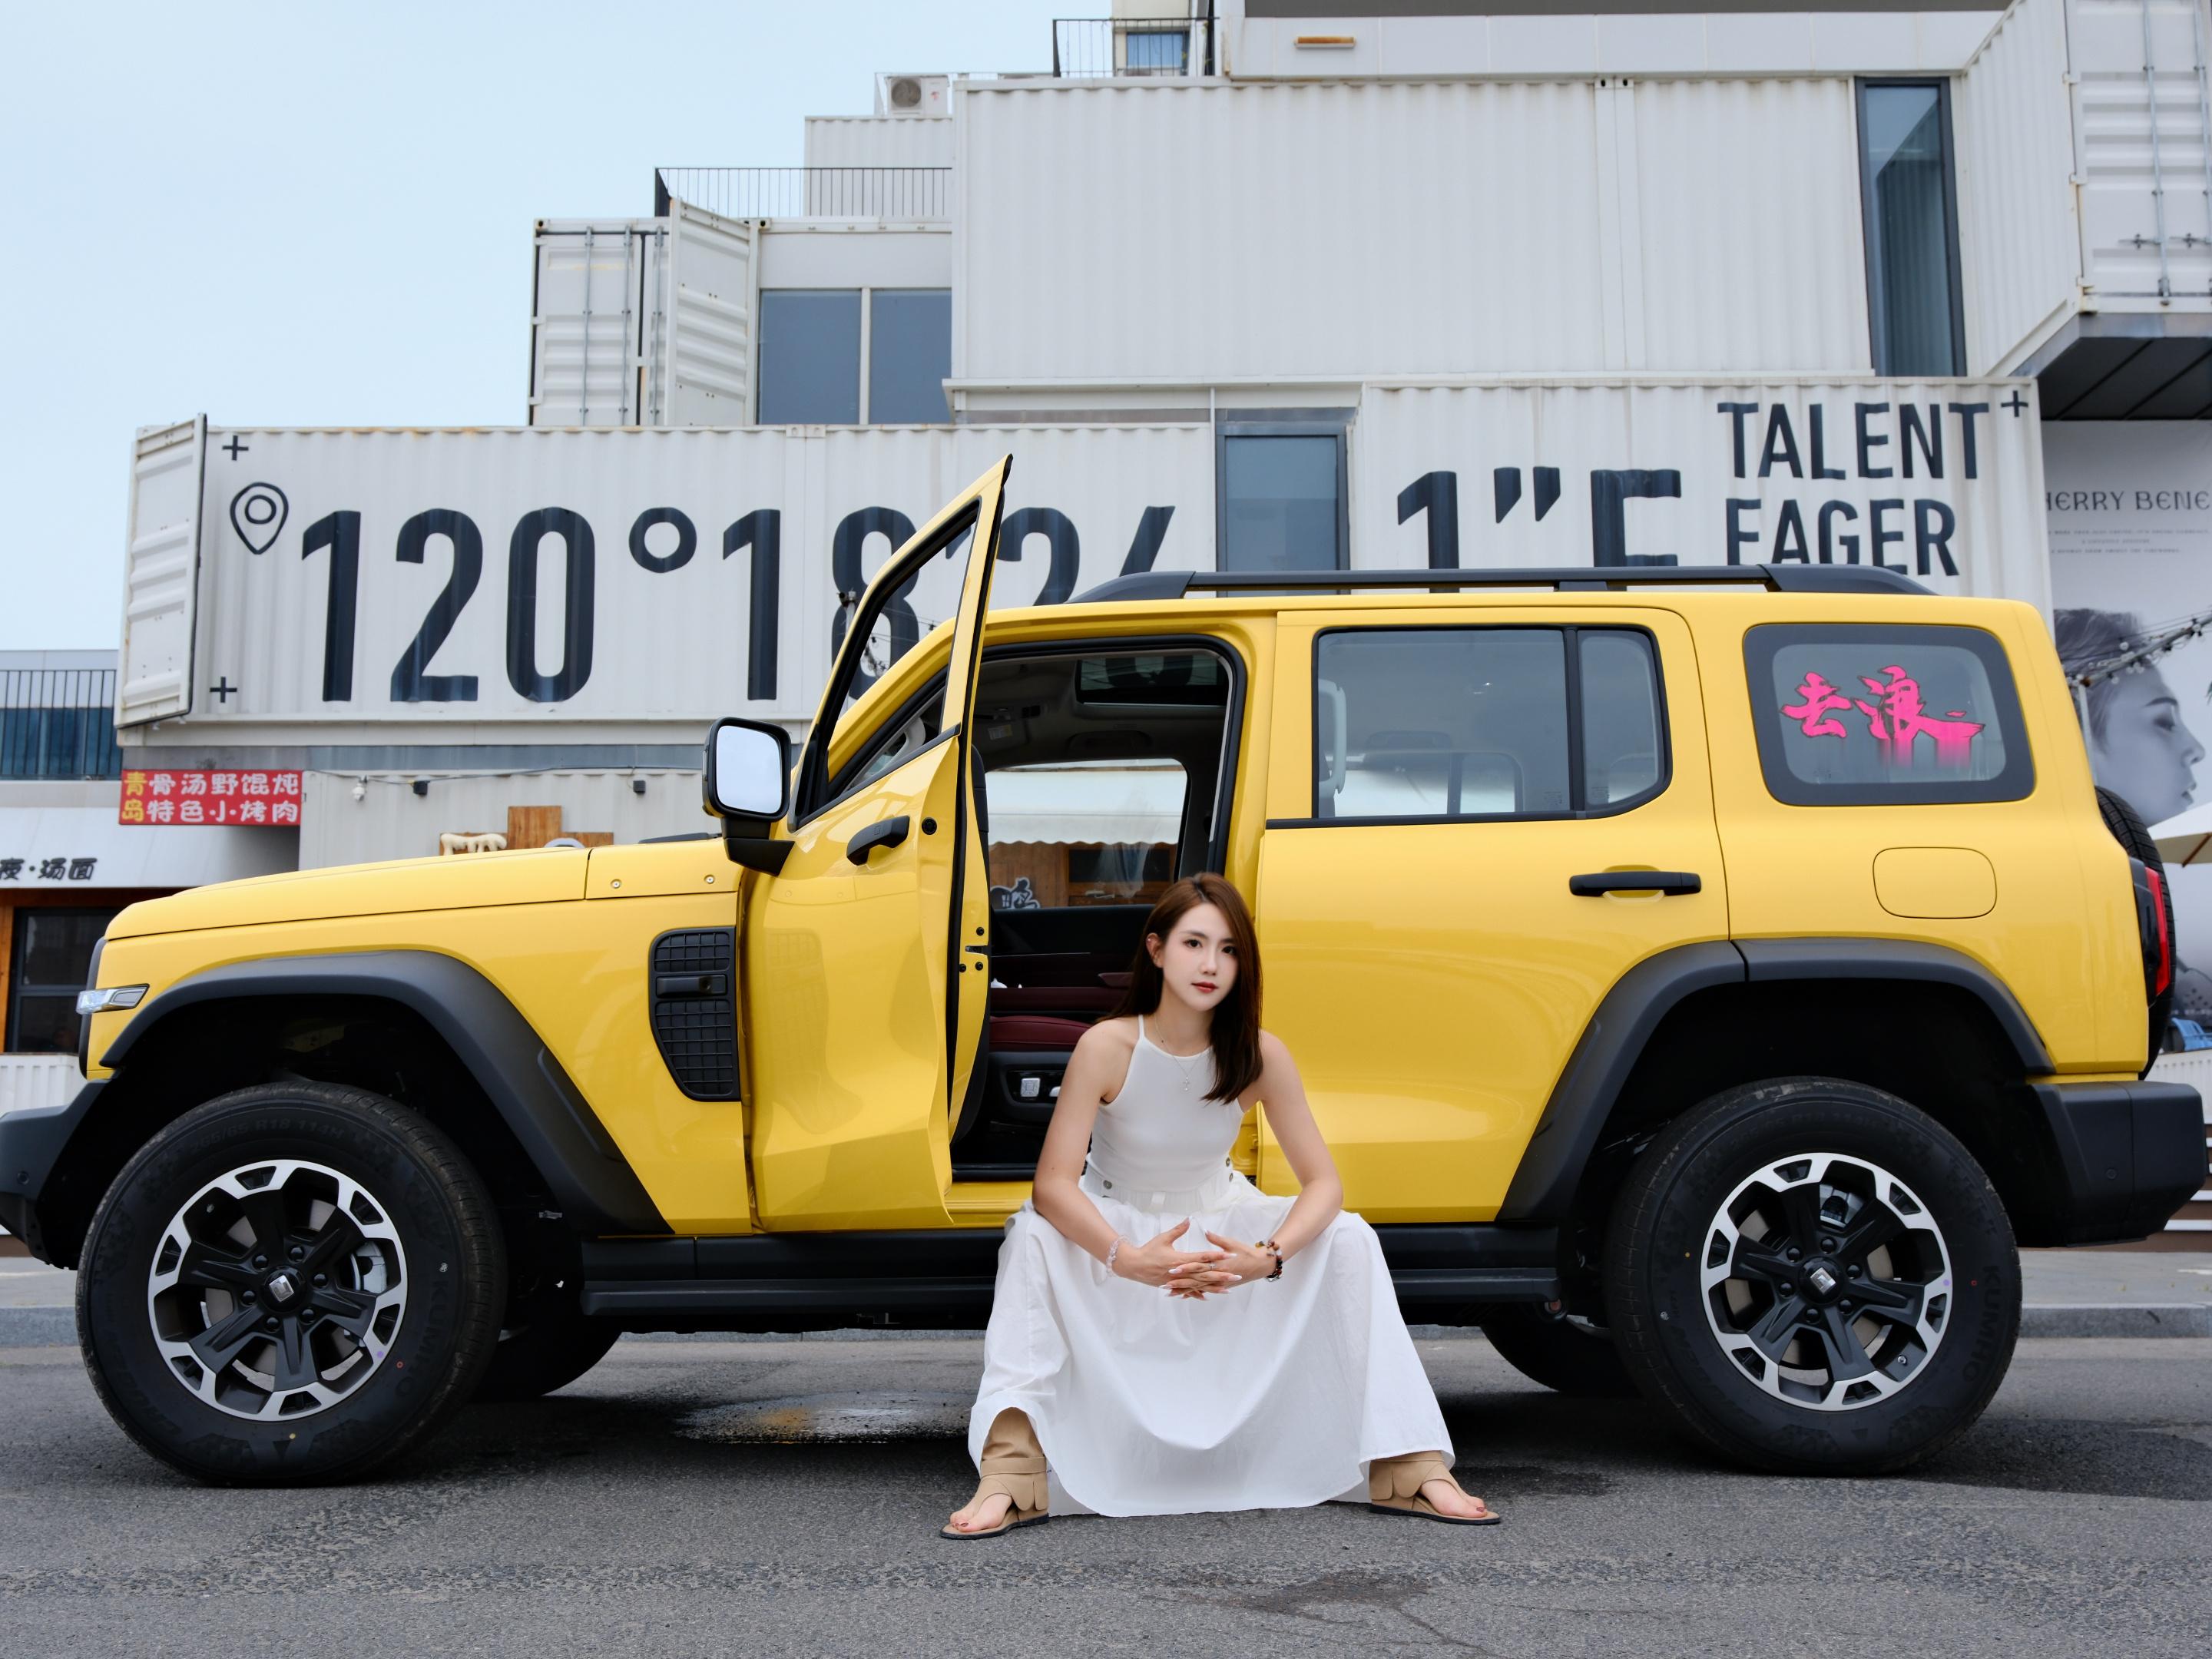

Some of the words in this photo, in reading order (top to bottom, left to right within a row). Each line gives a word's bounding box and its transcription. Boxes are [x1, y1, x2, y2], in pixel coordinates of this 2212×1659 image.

[1717, 402, 1991, 480] TALENT
[1726, 498, 1960, 576] EAGER
[394, 1278, 450, 1399] KUMHO
[1962, 1263, 2003, 1385] KUMHO
